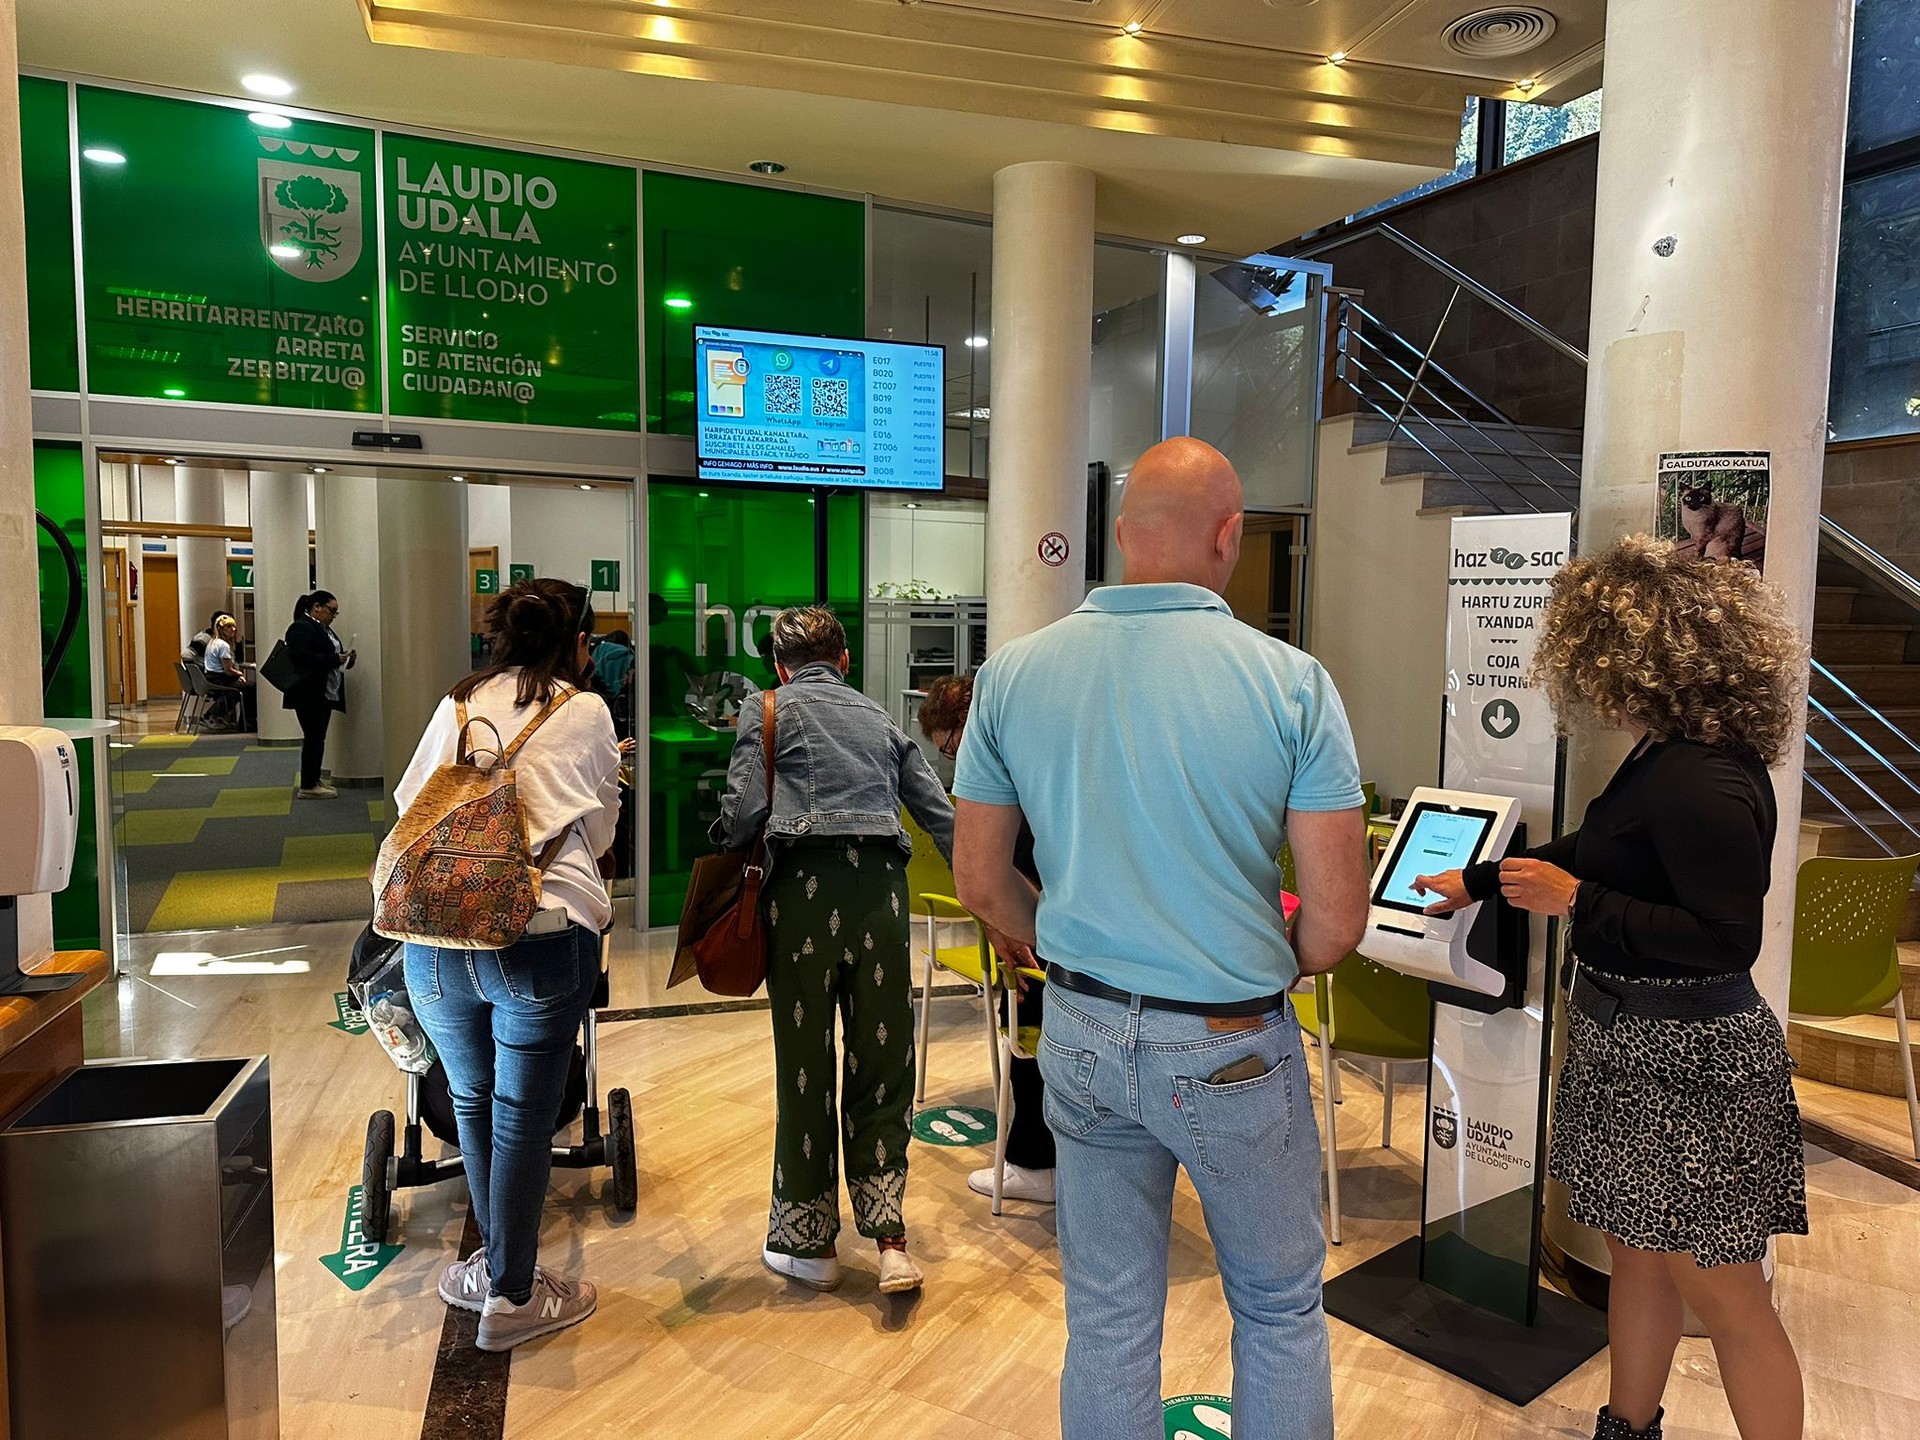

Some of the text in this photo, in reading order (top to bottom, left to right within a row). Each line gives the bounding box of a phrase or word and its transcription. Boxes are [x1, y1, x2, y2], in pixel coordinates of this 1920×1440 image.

[397, 157, 557, 209] LAUDIO
[398, 195, 541, 244] UDALA
[398, 240, 617, 286] AYUNTAMIENTO
[400, 269, 548, 306] DE LLODIO
[116, 295, 365, 337] HERRITARRENTZAKO
[401, 324, 499, 350] SERVICIO
[275, 336, 366, 362] ARRETA
[403, 348, 542, 378] DE ATENCIÓN
[872, 357, 891, 365] E017
[227, 357, 366, 391] ZERBITZU@
[873, 369, 893, 378] B020
[402, 372, 535, 404] CIUDADAN@
[872, 382, 897, 391] ZT007
[873, 394, 892, 402] B019
[873, 406, 892, 415] B018
[704, 426, 743, 435] HARPIDETU
[766, 416, 801, 426] WhatsApp
[815, 420, 846, 428] Telegram
[704, 433, 731, 441] ERRAZA
[704, 440, 744, 449] SUSCRÍBETE
[766, 444, 795, 452] CANALES
[1666, 459, 1766, 469] GALDUTAKO KATUA
[1454, 548, 1564, 568] haz sac
[241, 565, 254, 583] 7
[479, 574, 490, 590] 3
[598, 566, 608, 586] 1
[1461, 596, 1509, 609] HARTU
[1476, 616, 1534, 629] TXANDA
[1487, 655, 1520, 668] COJA
[1467, 674, 1485, 686] SU
[1467, 1117, 1513, 1141] LAUDIO
[1466, 1128, 1507, 1151] UDALA
[1465, 1142, 1531, 1169] AYUNTAMIENTO
[1465, 1150, 1509, 1171] DE LLODIO
[463, 1271, 479, 1294] N
[539, 1297, 563, 1318] N
